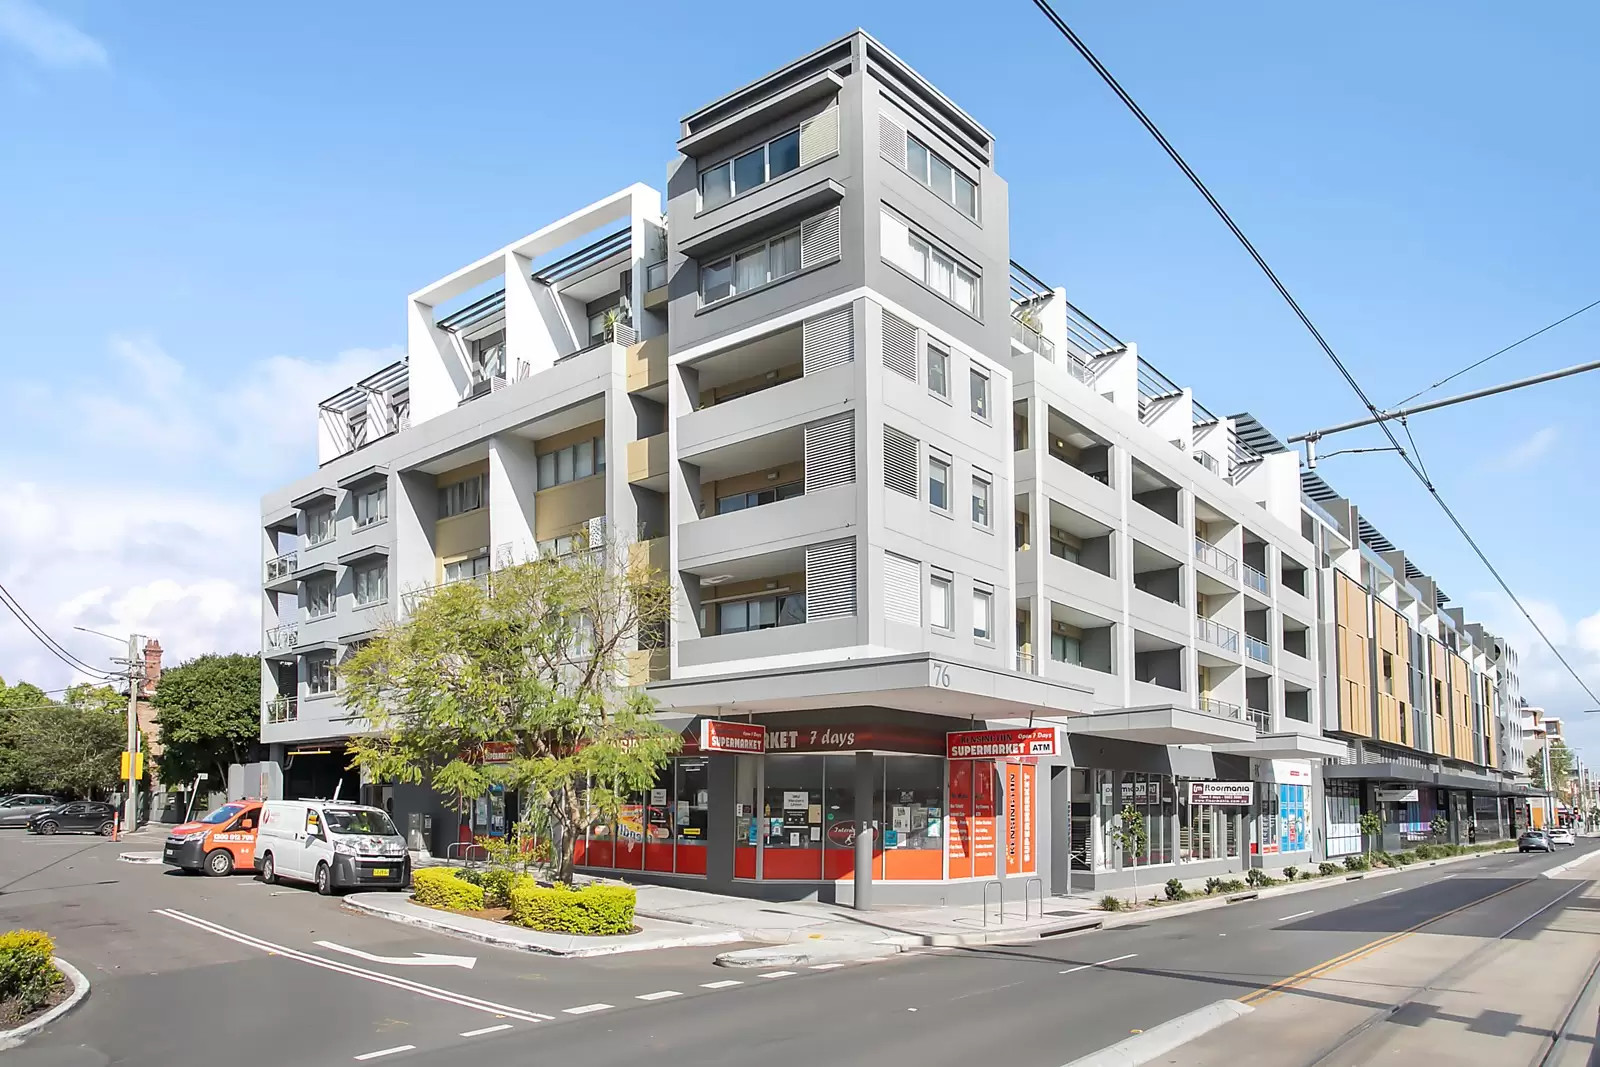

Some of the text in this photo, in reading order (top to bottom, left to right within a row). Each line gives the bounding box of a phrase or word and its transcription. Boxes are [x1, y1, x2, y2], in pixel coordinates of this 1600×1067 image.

[933, 662, 950, 687] 76
[712, 735, 761, 750] SUPERMARKET
[765, 728, 855, 749] RKET 7 days
[952, 743, 1050, 756] SUPERMARKET ATM
[1023, 773, 1031, 862] SUPERMARKET
